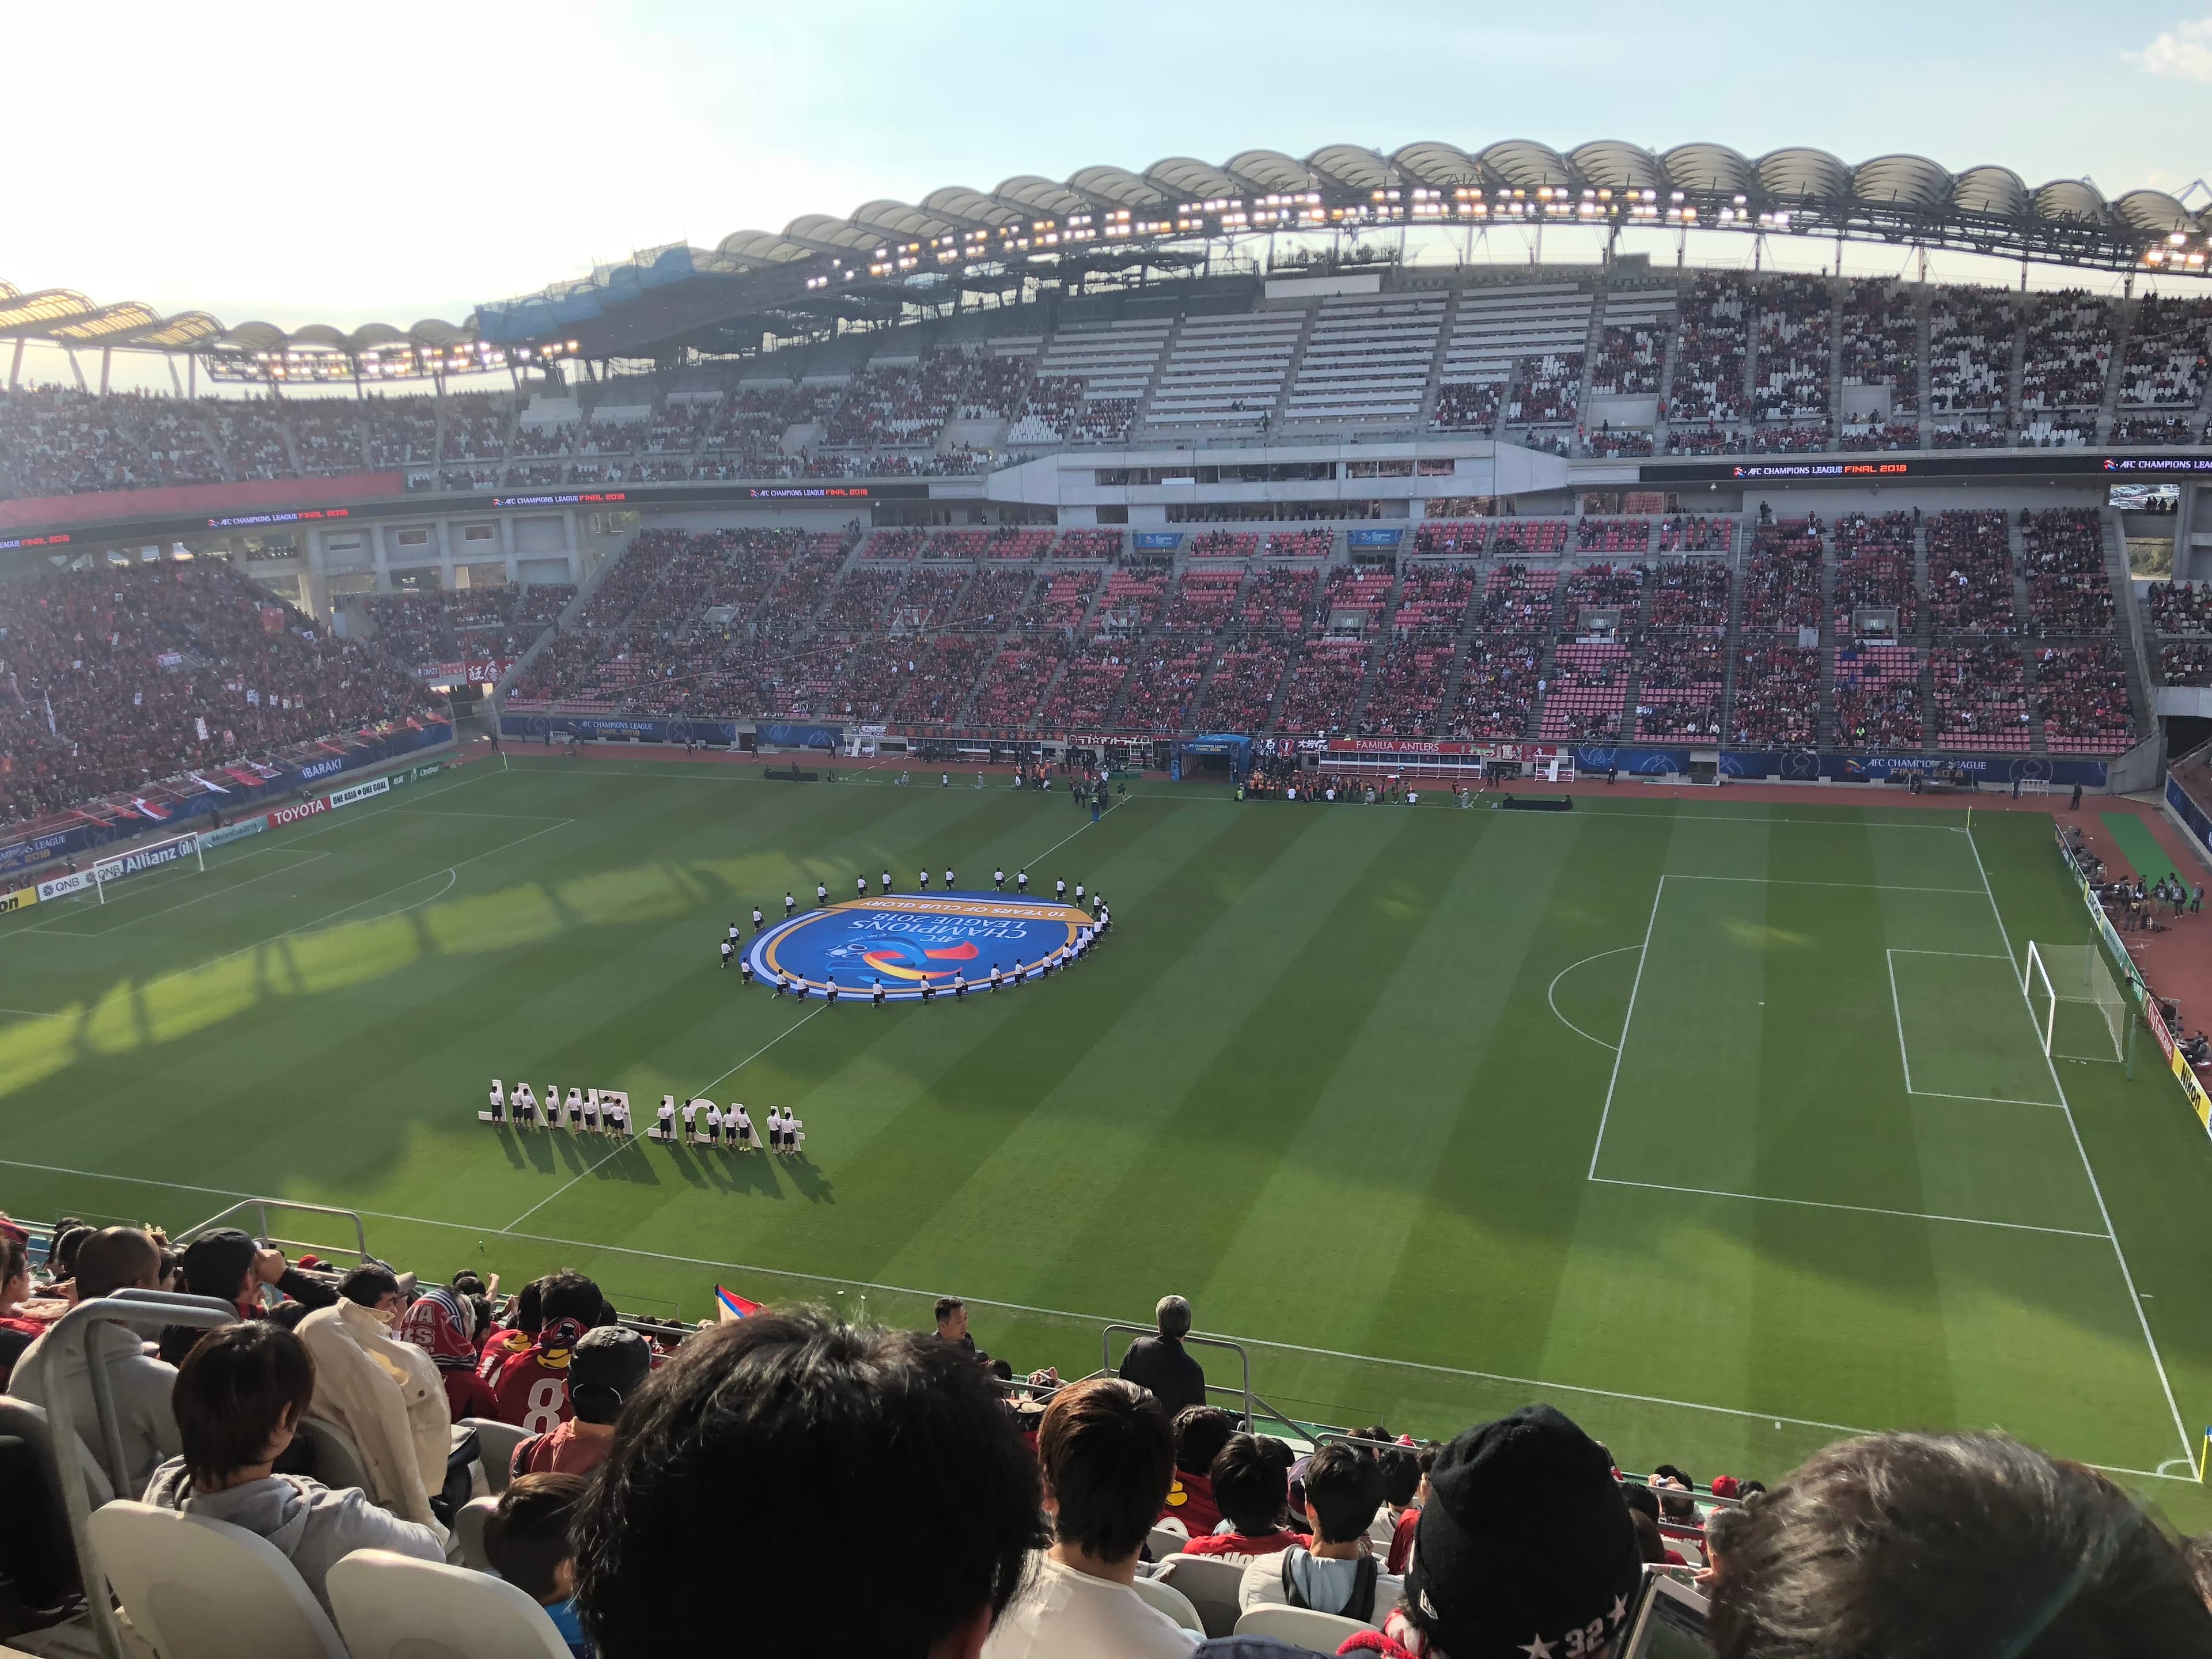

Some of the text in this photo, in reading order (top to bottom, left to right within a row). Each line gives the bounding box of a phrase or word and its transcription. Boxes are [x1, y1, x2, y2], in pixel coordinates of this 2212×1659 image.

[1763, 467, 1810, 475] CHAMPIONS
[2120, 460, 2136, 468] AFC
[2138, 460, 2191, 468] CHAMPIONS
[517, 497, 554, 505] CHAMPIONS
[555, 495, 578, 503] LEAGUE
[233, 515, 271, 525] CHAMPIONS
[272, 513, 298, 521] LEAGUE
[298, 510, 325, 519] FINAL
[593, 721, 628, 729] CHAMPIONS
[630, 722, 653, 730] LEAGUE
[1356, 740, 1394, 750] FAMILIA
[1400, 741, 1440, 752] ANTLERS
[302, 757, 342, 779] IBARAKI
[1867, 759, 1885, 767] AFC
[333, 781, 387, 805] ONE ASIA ONE GOAL
[274, 799, 325, 824] TOYOTA
[35, 835, 67, 850] LEAGUE
[24, 849, 51, 863] 2018
[126, 847, 178, 873] Allianz
[98, 864, 121, 879] QNB
[56, 877, 79, 892] QNB
[861, 900, 916, 909] GLORY
[921, 903, 961, 911] CLUB
[993, 907, 1042, 916] YEARS
[872, 912, 1027, 928] LEAGUE 2018
[847, 920, 1028, 940] CHAMPIONS
[919, 934, 965, 943] AFC
[2180, 1062, 2202, 1111] Nikon
[523, 1377, 565, 1434] 8
[1566, 1617, 1606, 1658] 32
